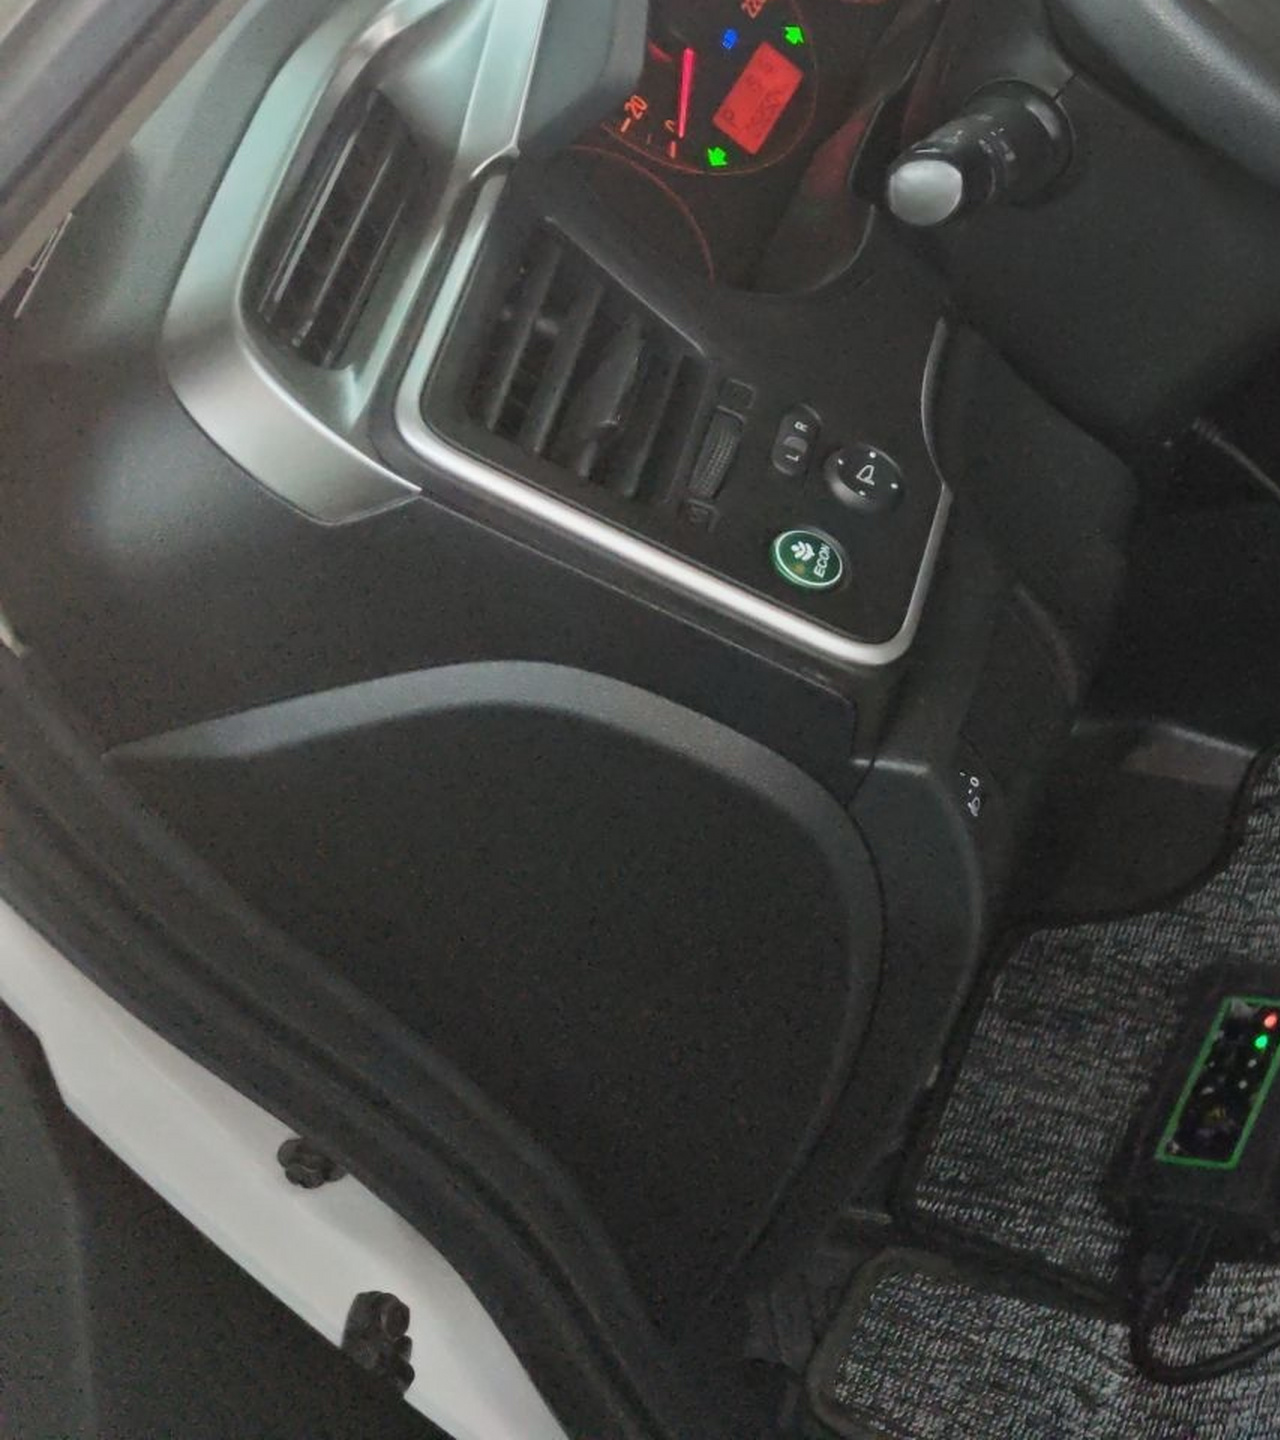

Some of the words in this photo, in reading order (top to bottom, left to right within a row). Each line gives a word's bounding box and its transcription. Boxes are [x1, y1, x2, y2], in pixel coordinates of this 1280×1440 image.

[624, 94, 648, 119] 20
[794, 421, 808, 432] R
[785, 453, 800, 462] L
[813, 543, 831, 579] ECON
